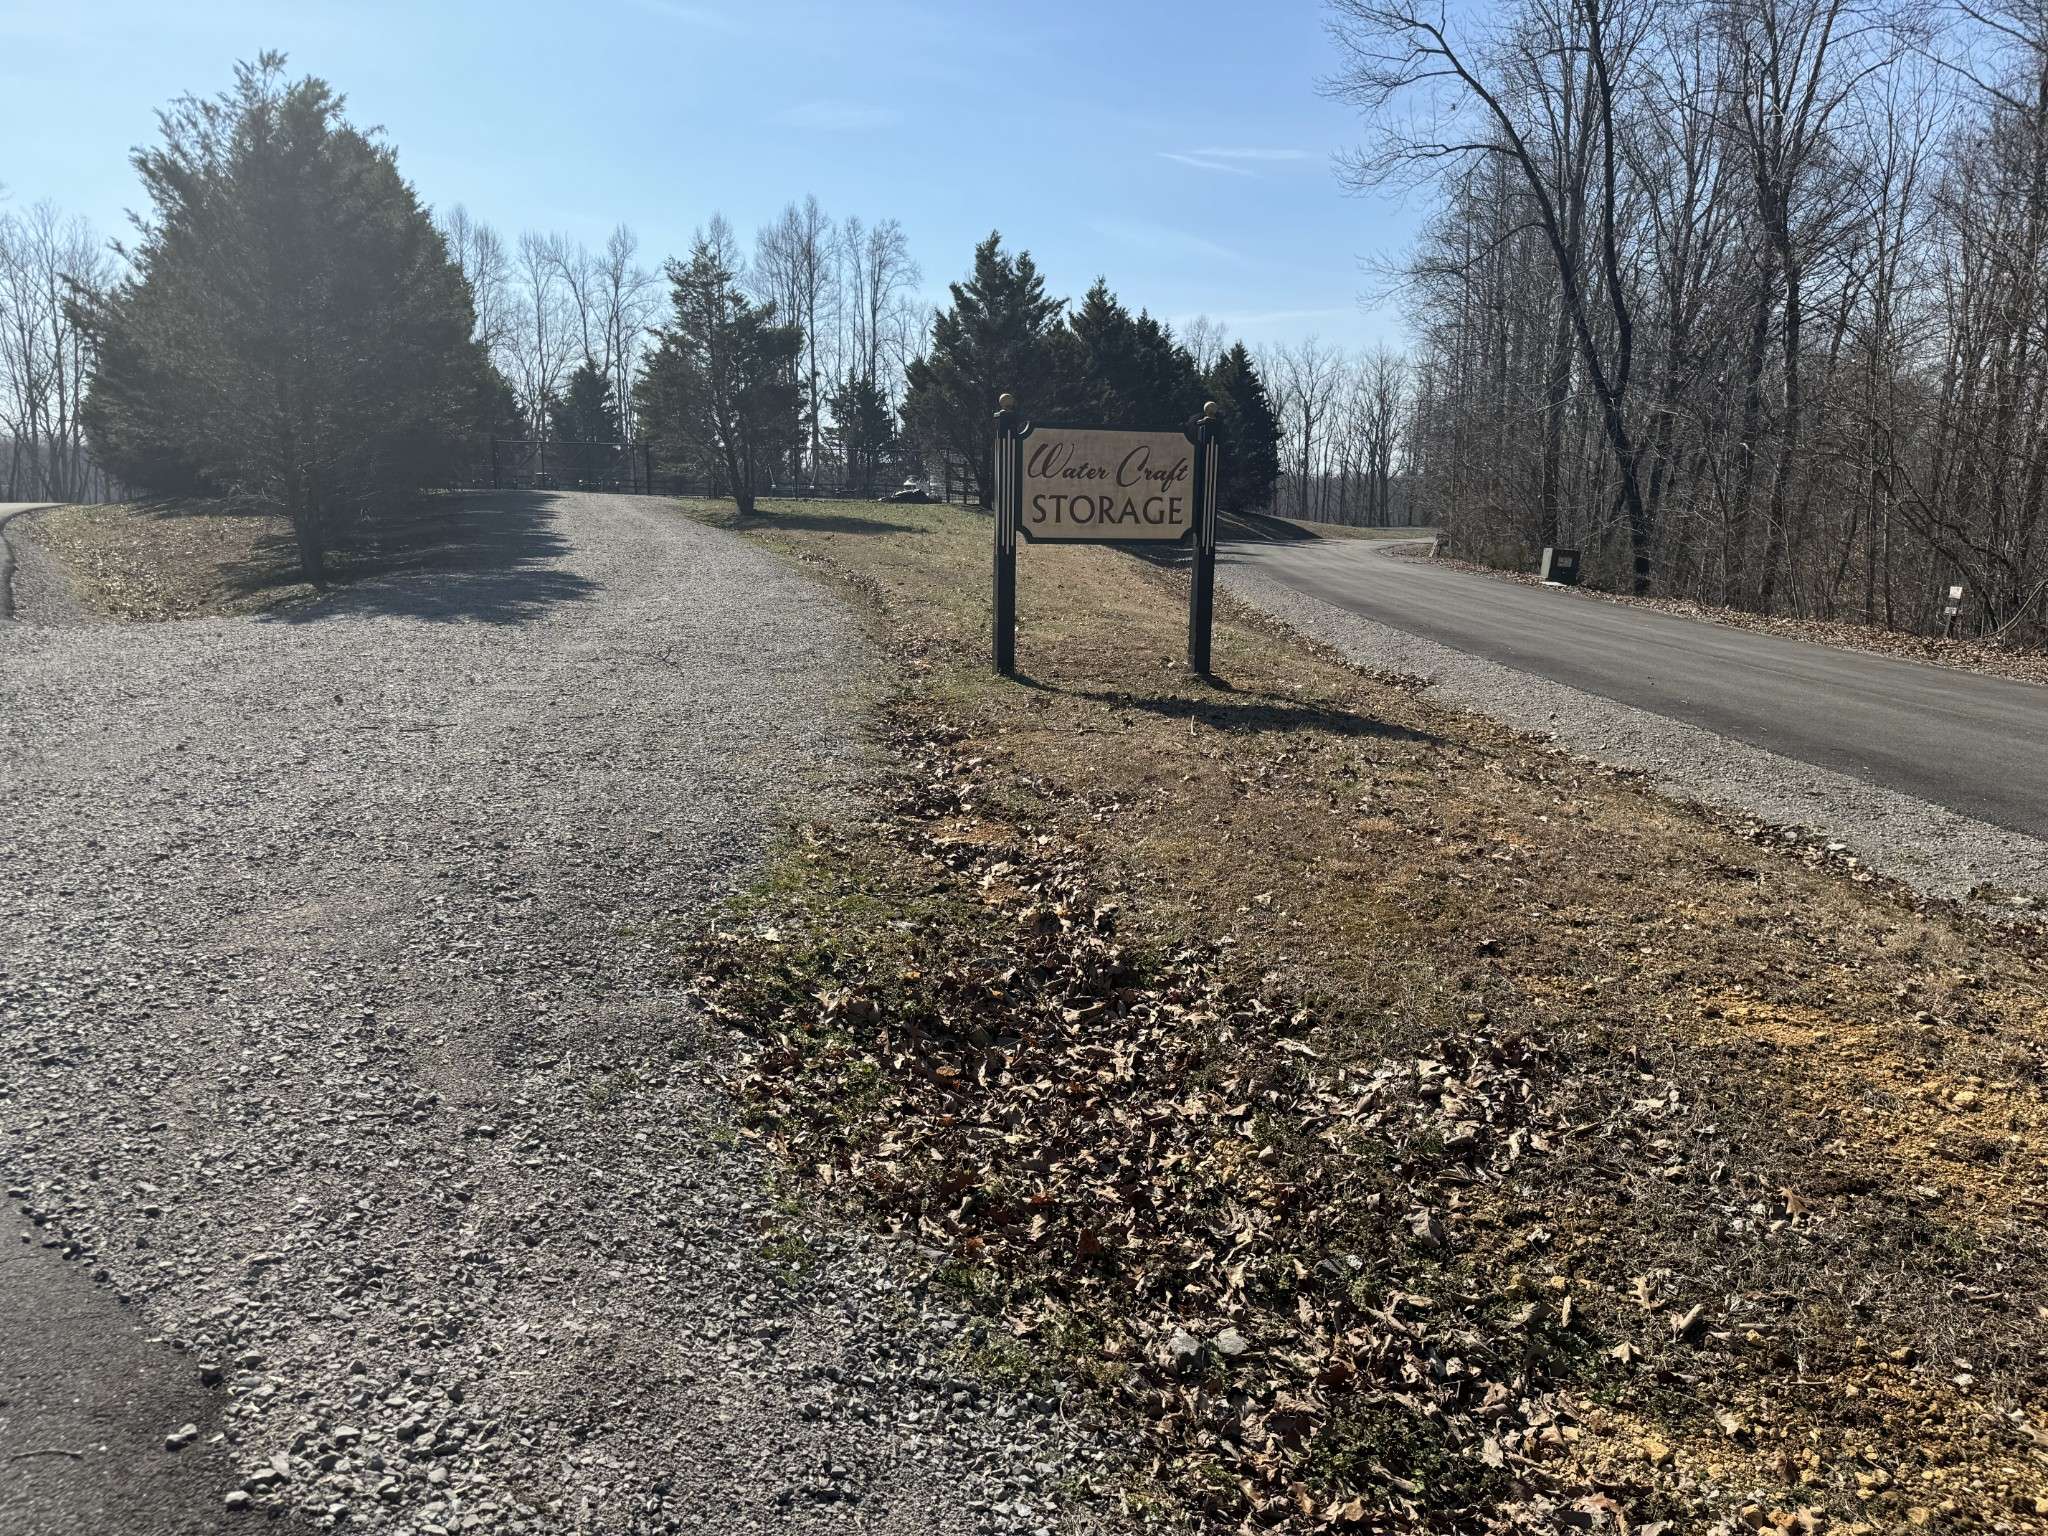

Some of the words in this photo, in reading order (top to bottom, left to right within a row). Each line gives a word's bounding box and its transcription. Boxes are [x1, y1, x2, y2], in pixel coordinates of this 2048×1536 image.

[1027, 443, 1110, 480] Water
[1115, 445, 1189, 492] Craft
[1032, 494, 1183, 525] STORAGE
